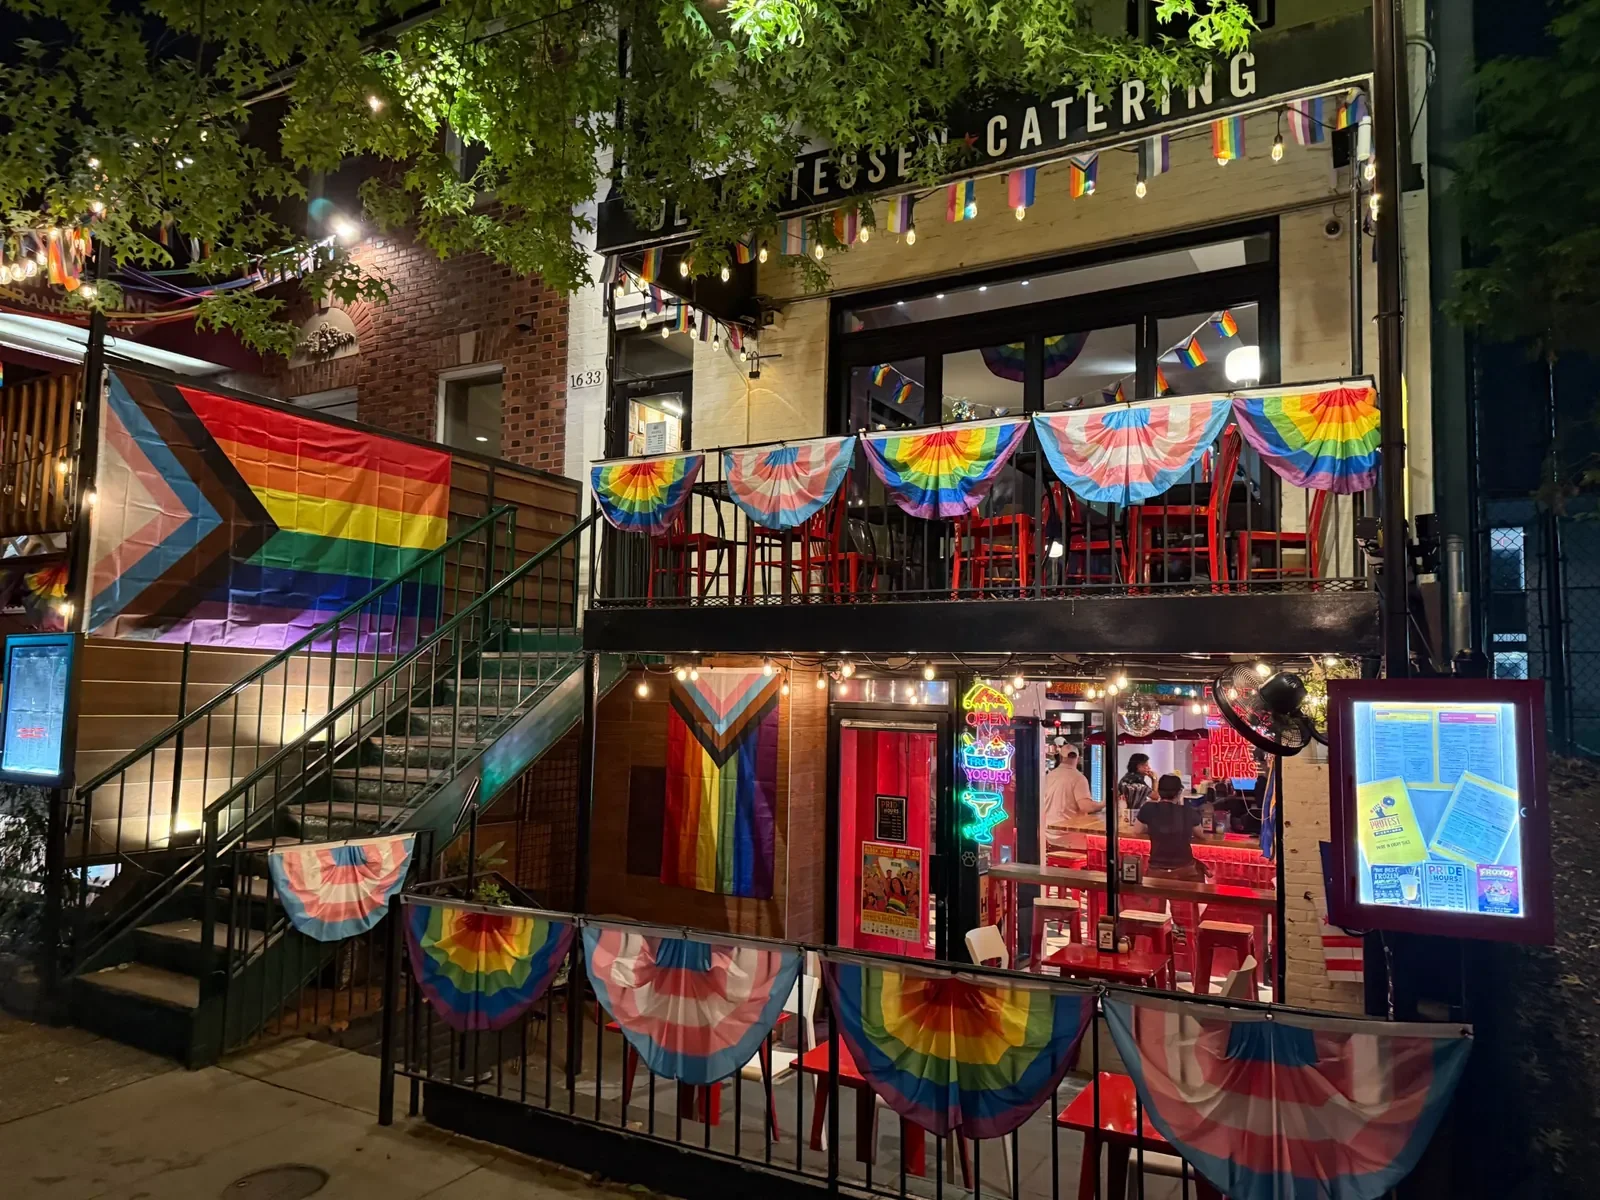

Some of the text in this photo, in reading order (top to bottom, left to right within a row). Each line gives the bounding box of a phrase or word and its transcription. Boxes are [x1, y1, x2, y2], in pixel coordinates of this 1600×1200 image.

[986, 51, 1256, 157] CATERING
[570, 370, 602, 388] 1633
[965, 711, 1011, 727] OPEN
[1210, 743, 1250, 762] PIZZA
[968, 757, 1006, 768] FROZEN
[1211, 761, 1256, 779] LOVERS
[967, 768, 1011, 783] YOGURT
[1369, 815, 1400, 830] PROTEST
[895, 848, 911, 856] JUNE
[1428, 865, 1462, 876] PRIDE
[1433, 874, 1459, 883] HOURS
